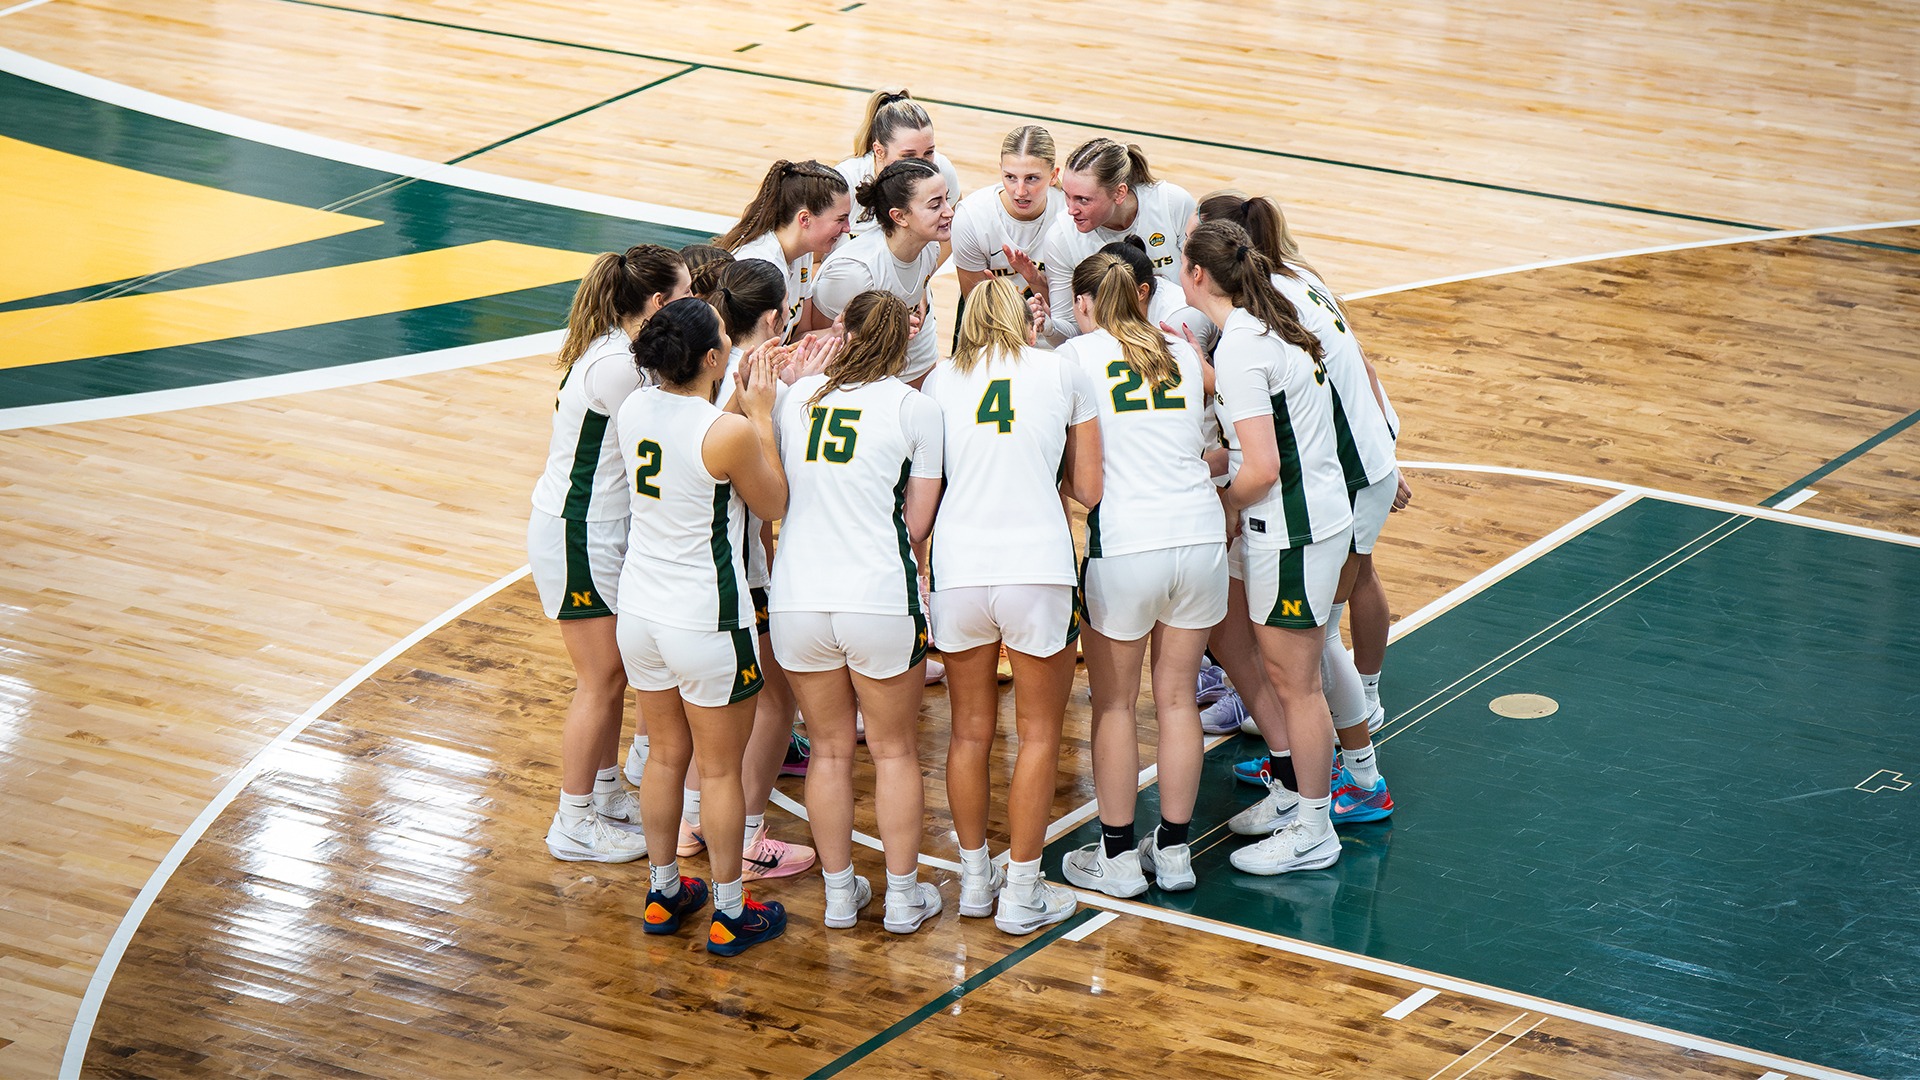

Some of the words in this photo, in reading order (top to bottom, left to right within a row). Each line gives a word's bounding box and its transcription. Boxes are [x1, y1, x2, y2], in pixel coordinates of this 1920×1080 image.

[976, 378, 1016, 434] 4
[1106, 360, 1187, 414] 22
[804, 406, 862, 464] 15
[636, 438, 662, 500] 2
[571, 591, 592, 607] N
[1281, 599, 1302, 617] N
[919, 627, 928, 648] N
[742, 663, 757, 685] N
